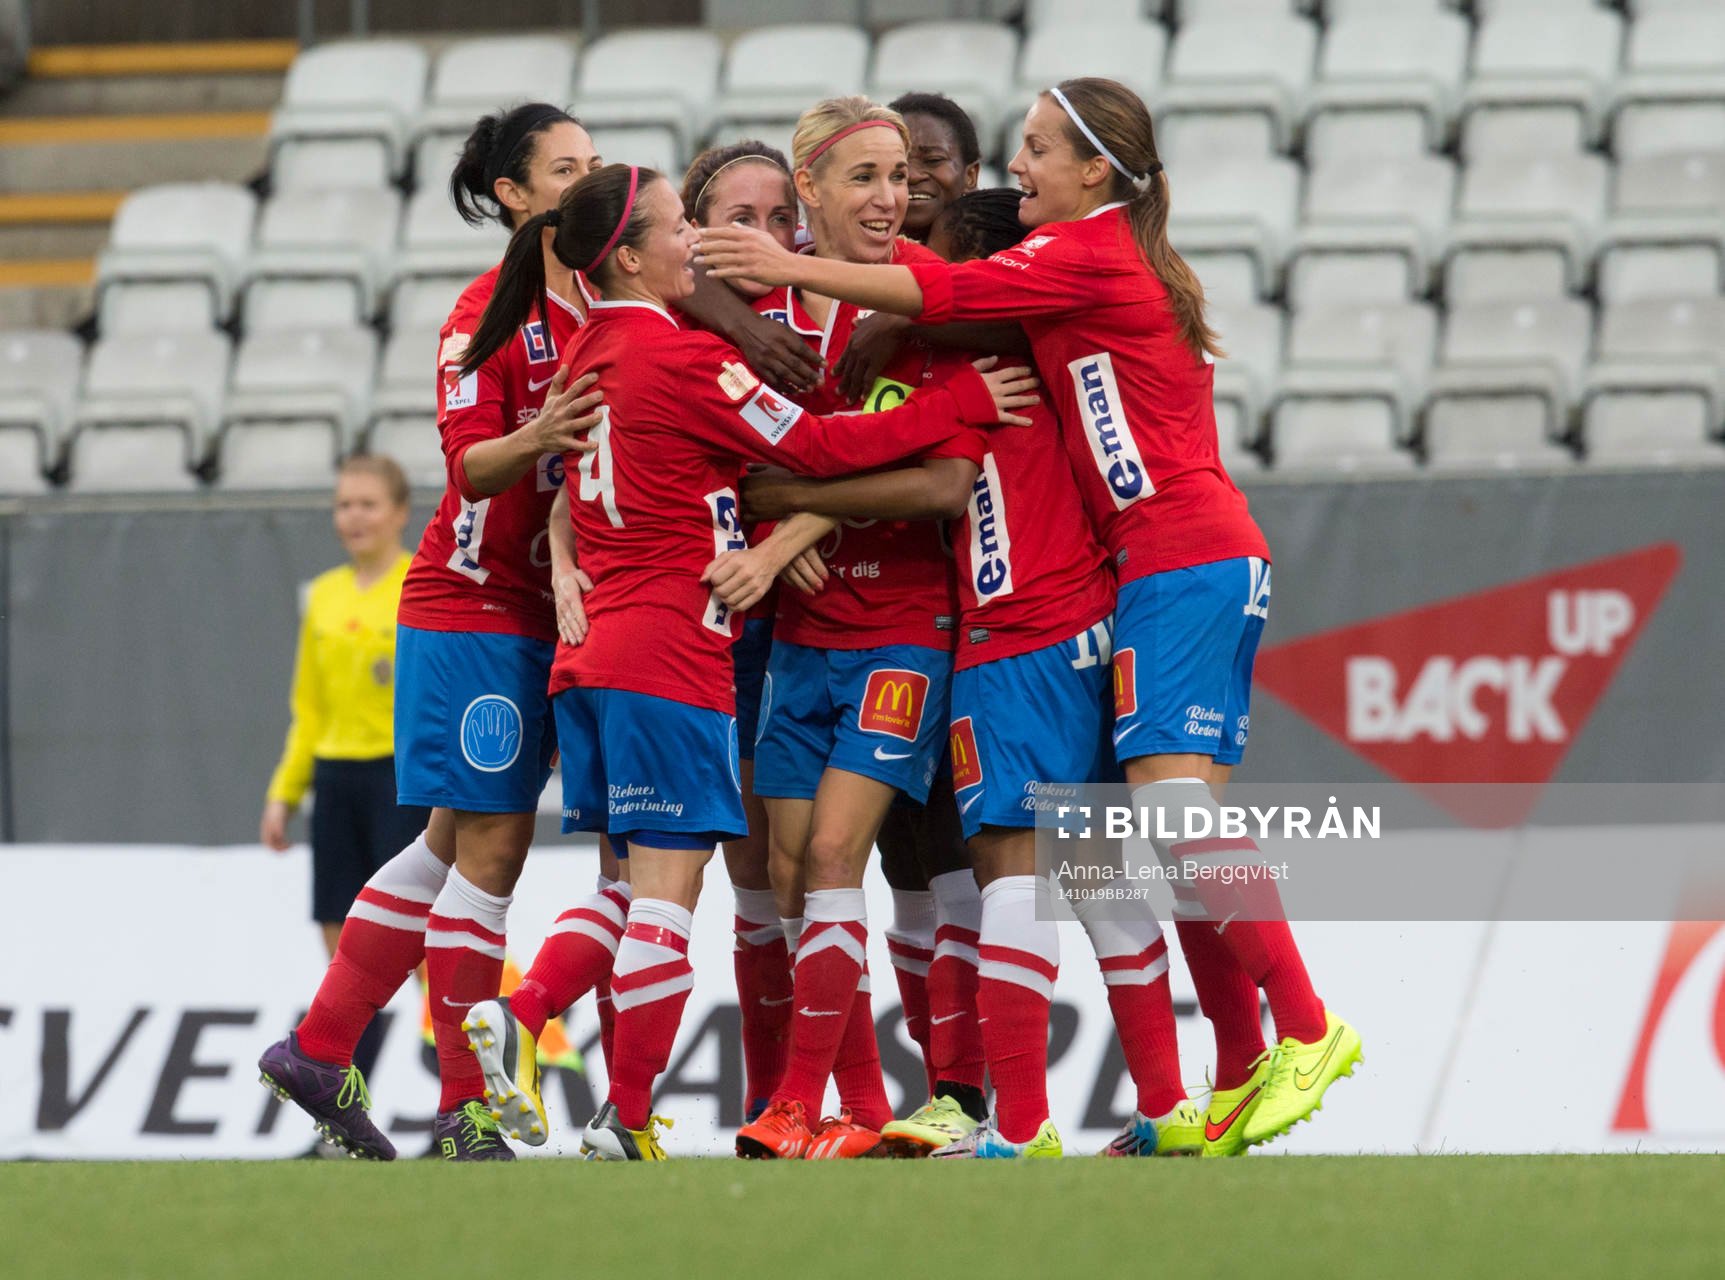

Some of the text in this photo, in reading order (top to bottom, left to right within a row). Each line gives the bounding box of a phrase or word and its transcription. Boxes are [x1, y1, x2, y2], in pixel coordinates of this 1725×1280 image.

[874, 384, 905, 412] C
[1080, 361, 1143, 500] e-man
[578, 405, 625, 528] 4
[851, 560, 880, 579] dig
[1546, 590, 1634, 655] UP
[1346, 655, 1567, 742] BACK
